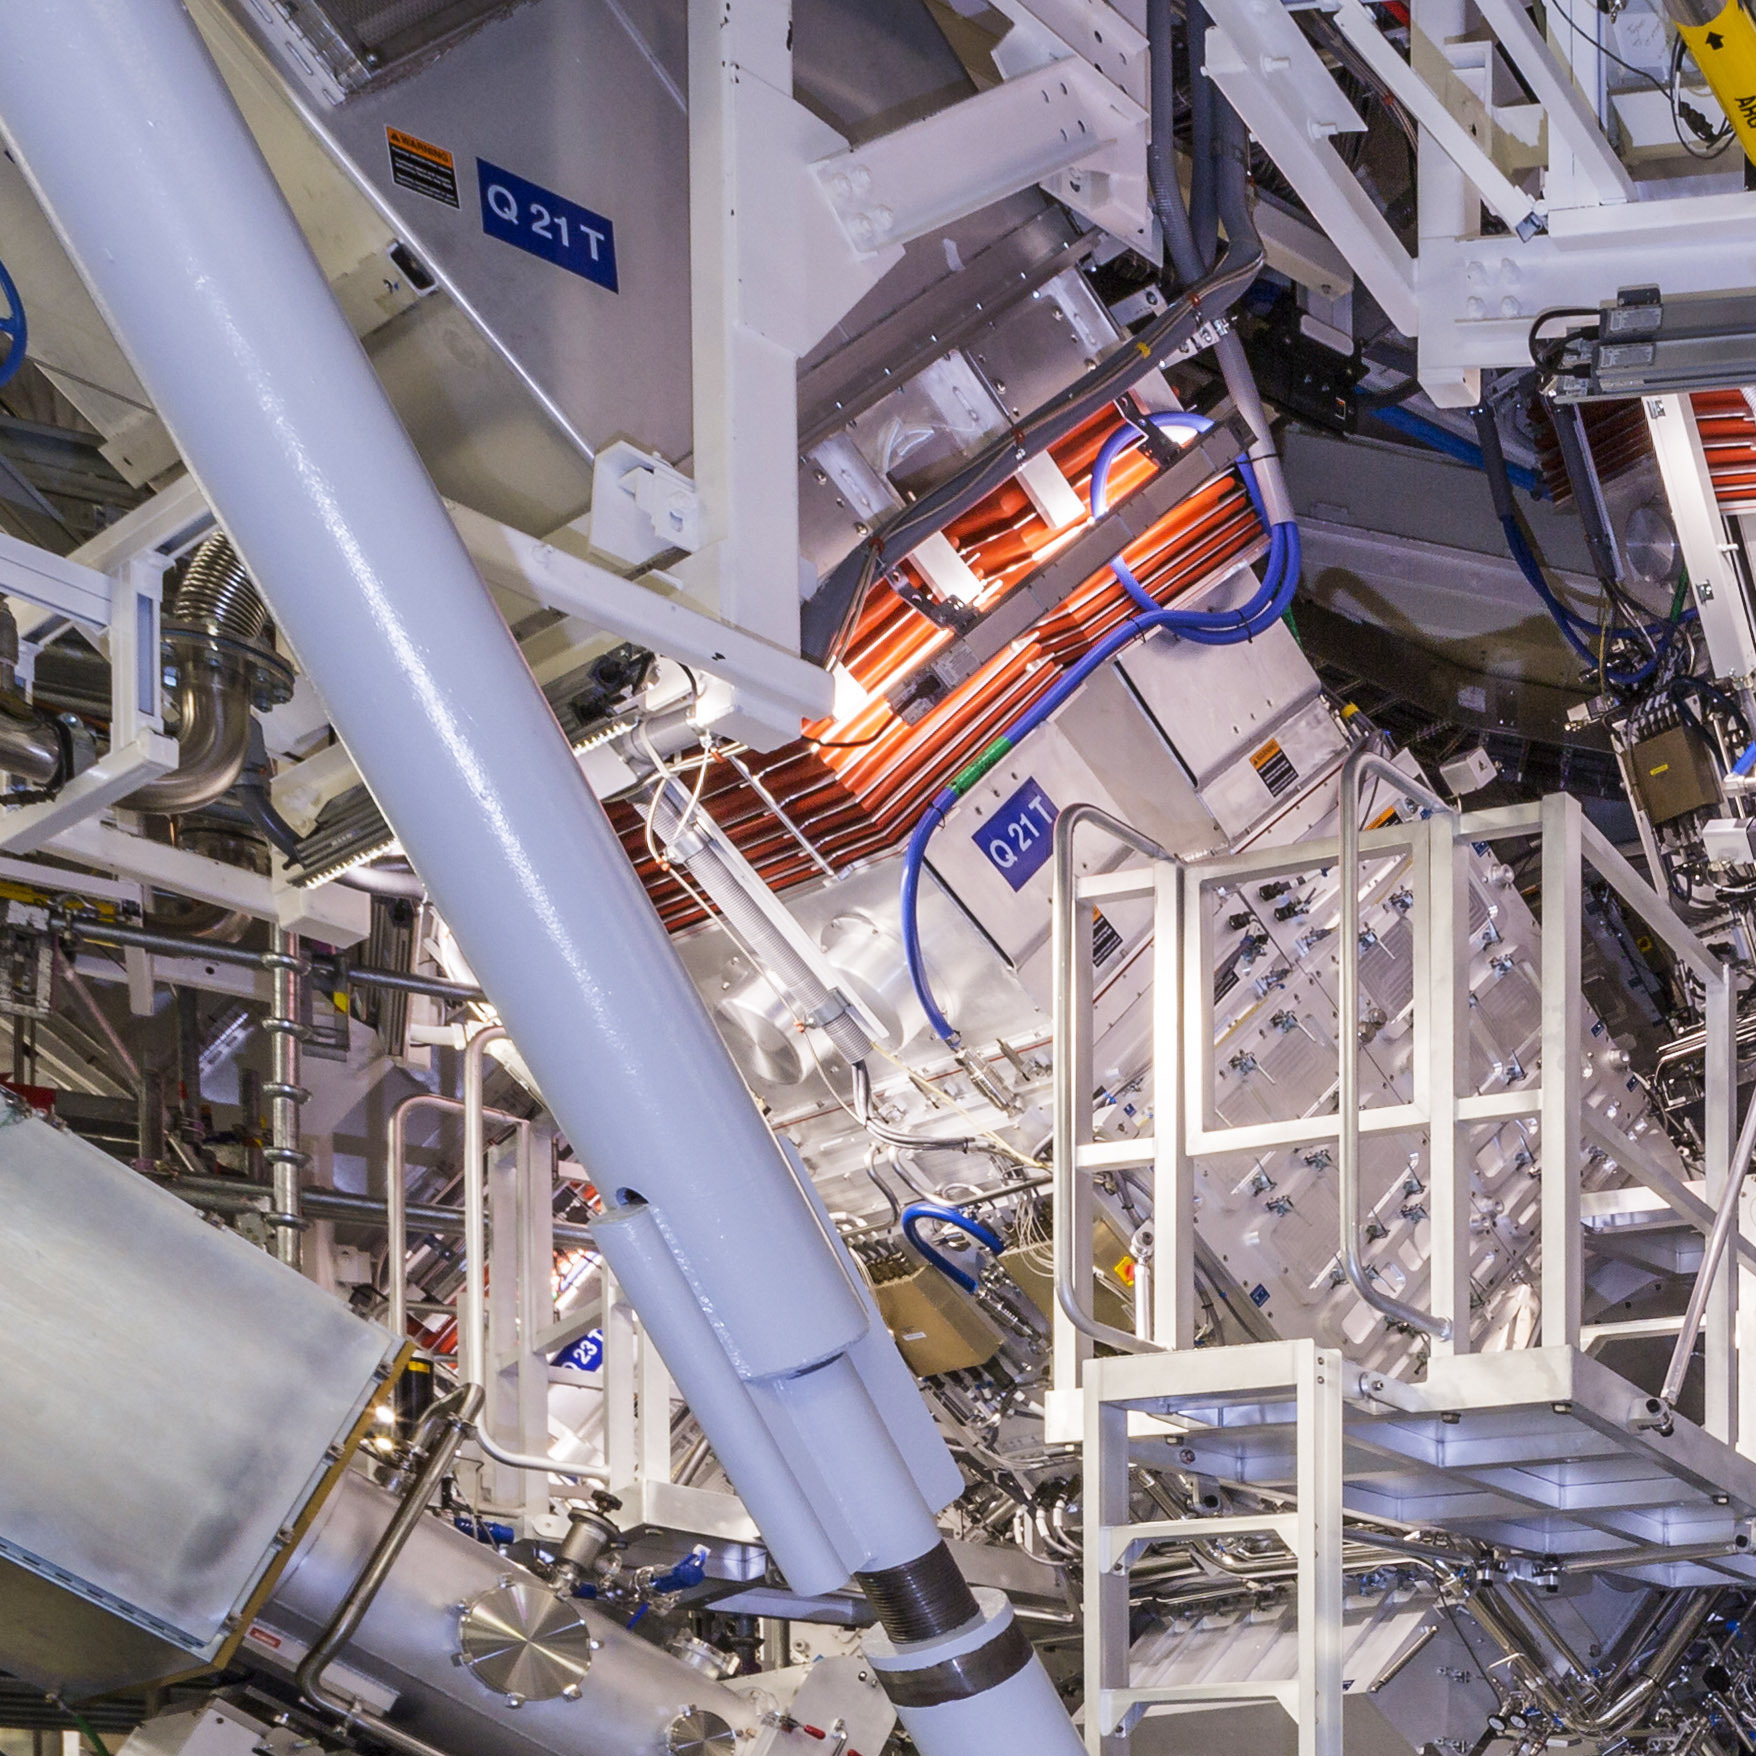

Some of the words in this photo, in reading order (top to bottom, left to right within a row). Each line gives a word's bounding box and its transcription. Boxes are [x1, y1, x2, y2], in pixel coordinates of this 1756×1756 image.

[487, 184, 520, 226] Q
[529, 203, 570, 249] 21
[580, 224, 605, 262] T
[989, 839, 1018, 869] Q
[1007, 812, 1041, 851] 21
[1028, 795, 1057, 824] T
[573, 1340, 598, 1365] 23
